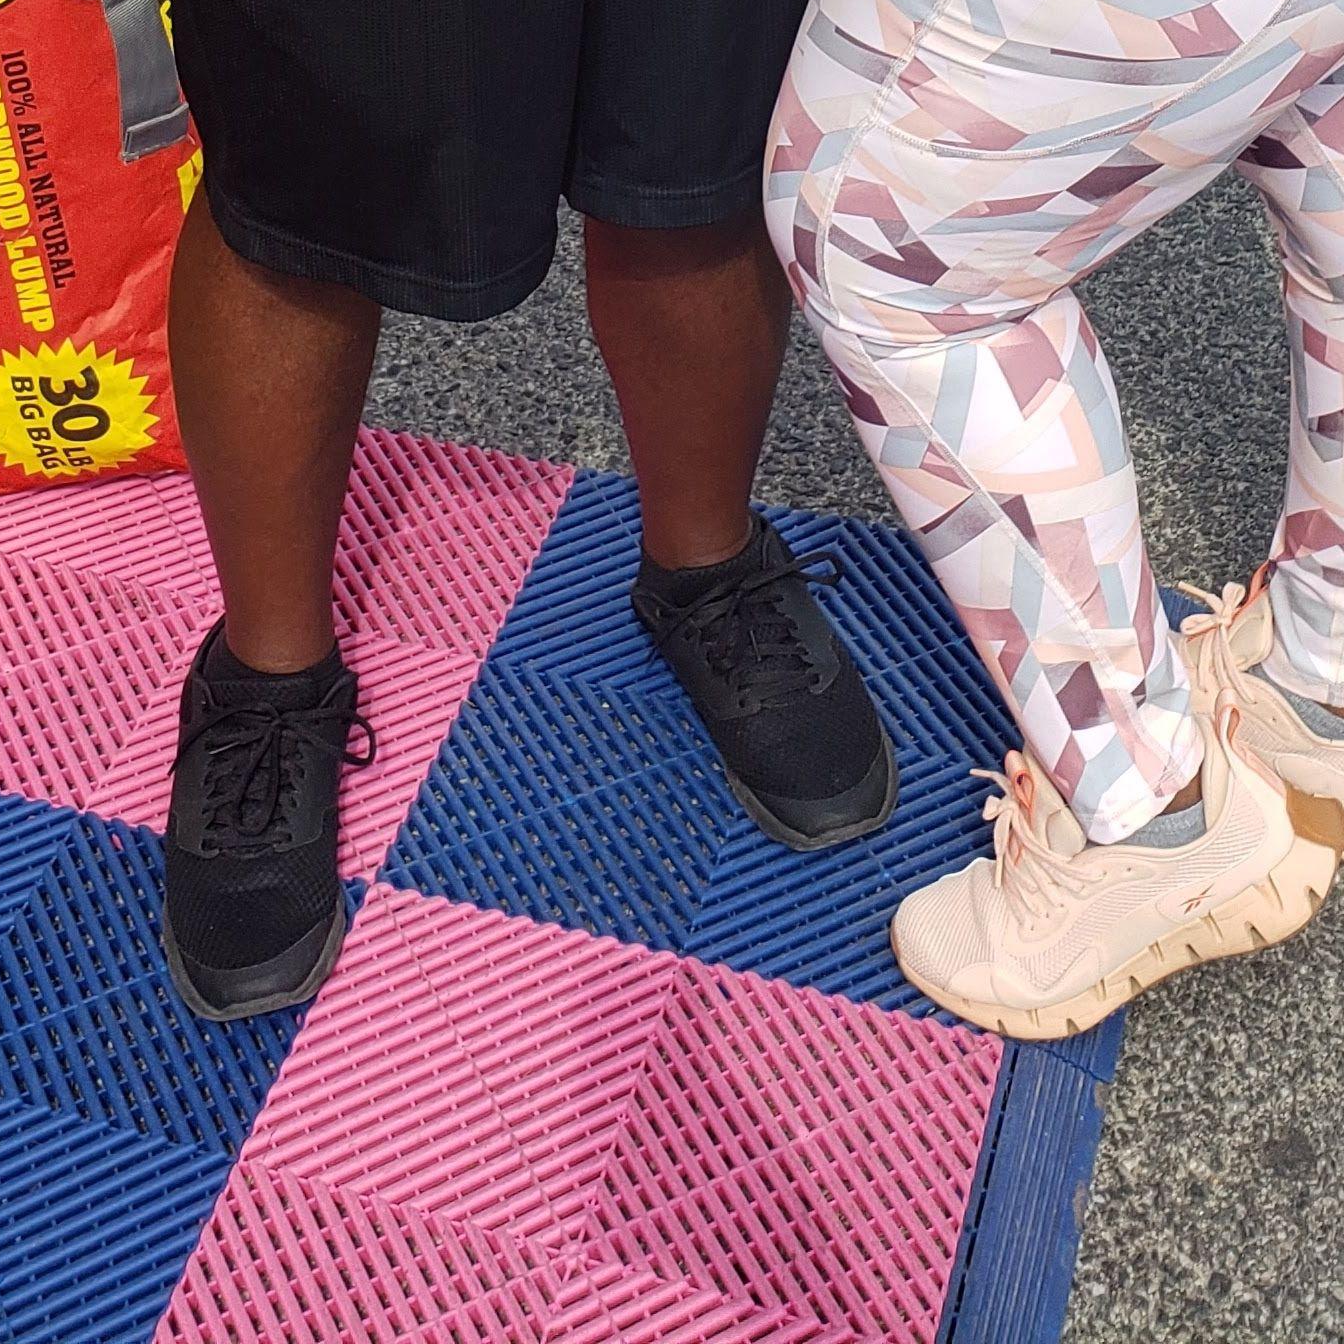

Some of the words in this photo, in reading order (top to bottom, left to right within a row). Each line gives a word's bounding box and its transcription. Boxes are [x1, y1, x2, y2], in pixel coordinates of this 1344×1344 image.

[0, 49, 38, 117] 100%
[17, 122, 49, 172] ALL
[29, 172, 77, 290] NATURAL
[6, 235, 56, 332] LUMP
[10, 375, 46, 421] BIG
[38, 364, 111, 442] 30
[25, 426, 68, 471] BAG
[61, 446, 95, 468] LB
